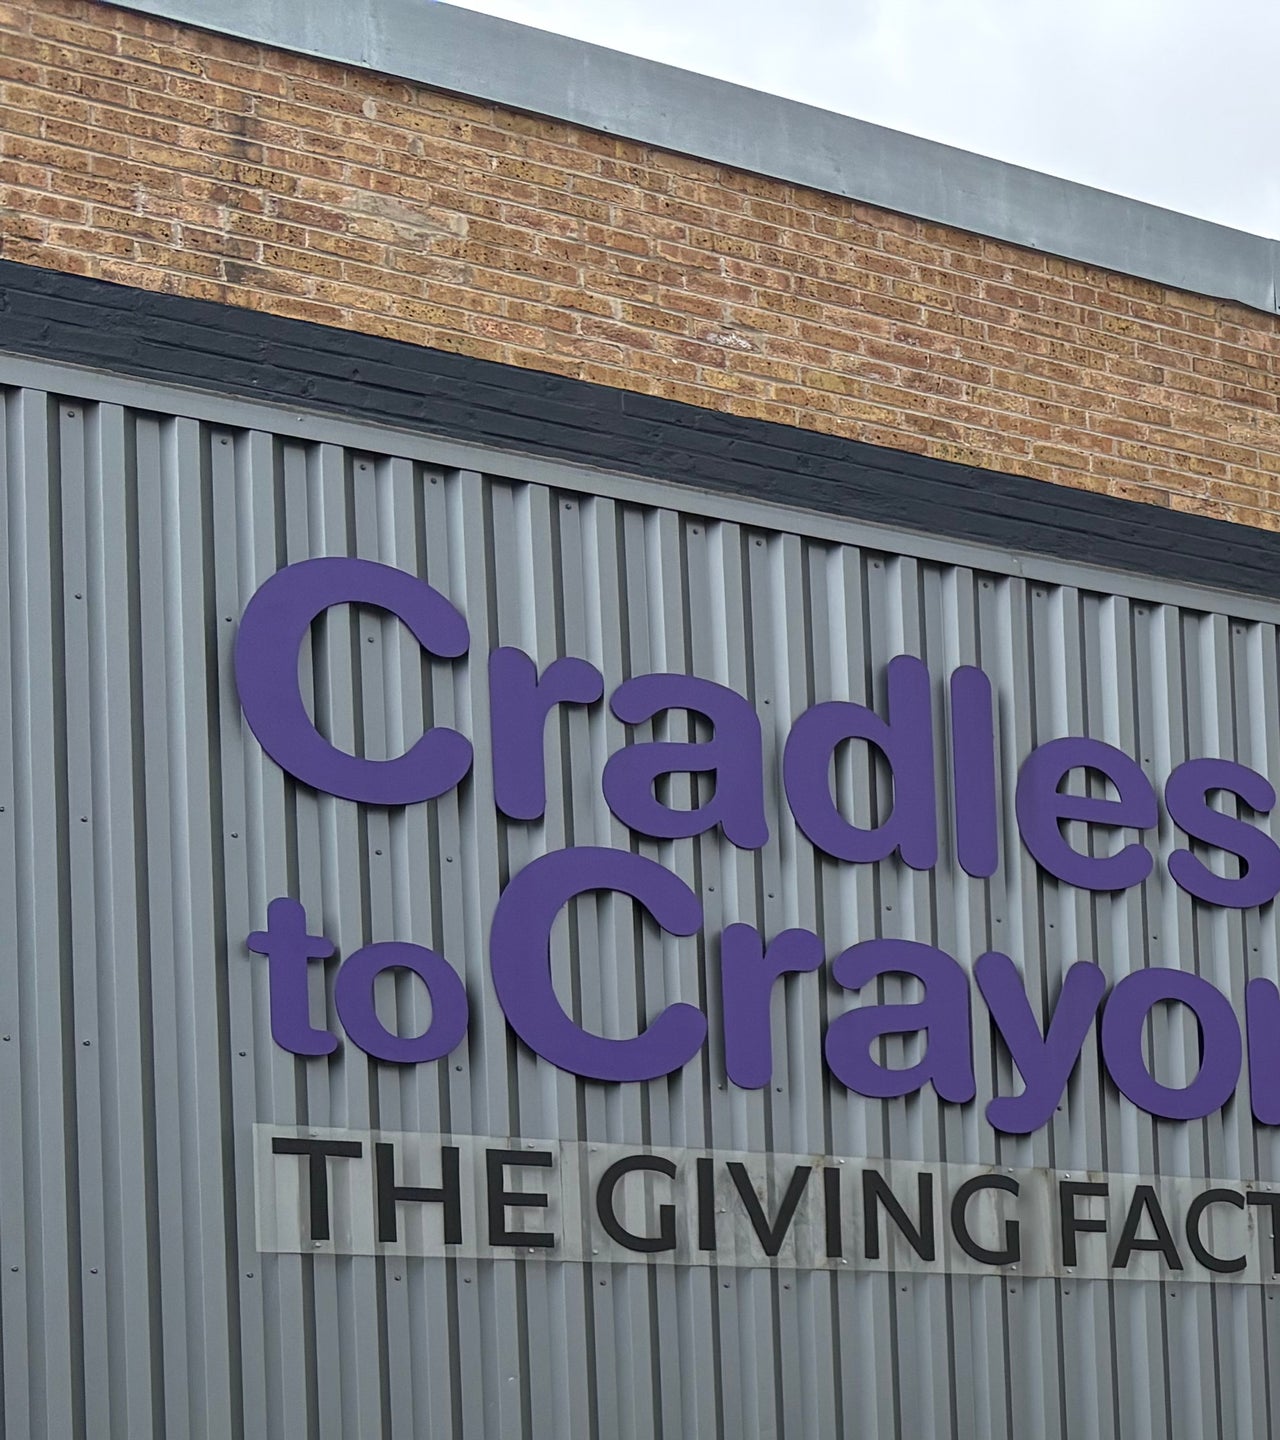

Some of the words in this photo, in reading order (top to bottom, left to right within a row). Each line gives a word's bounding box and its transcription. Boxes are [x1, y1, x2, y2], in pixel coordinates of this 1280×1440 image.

[248, 898, 467, 1065] to
[272, 1138, 554, 1248] THE
[596, 1155, 1020, 1266] GIVING
